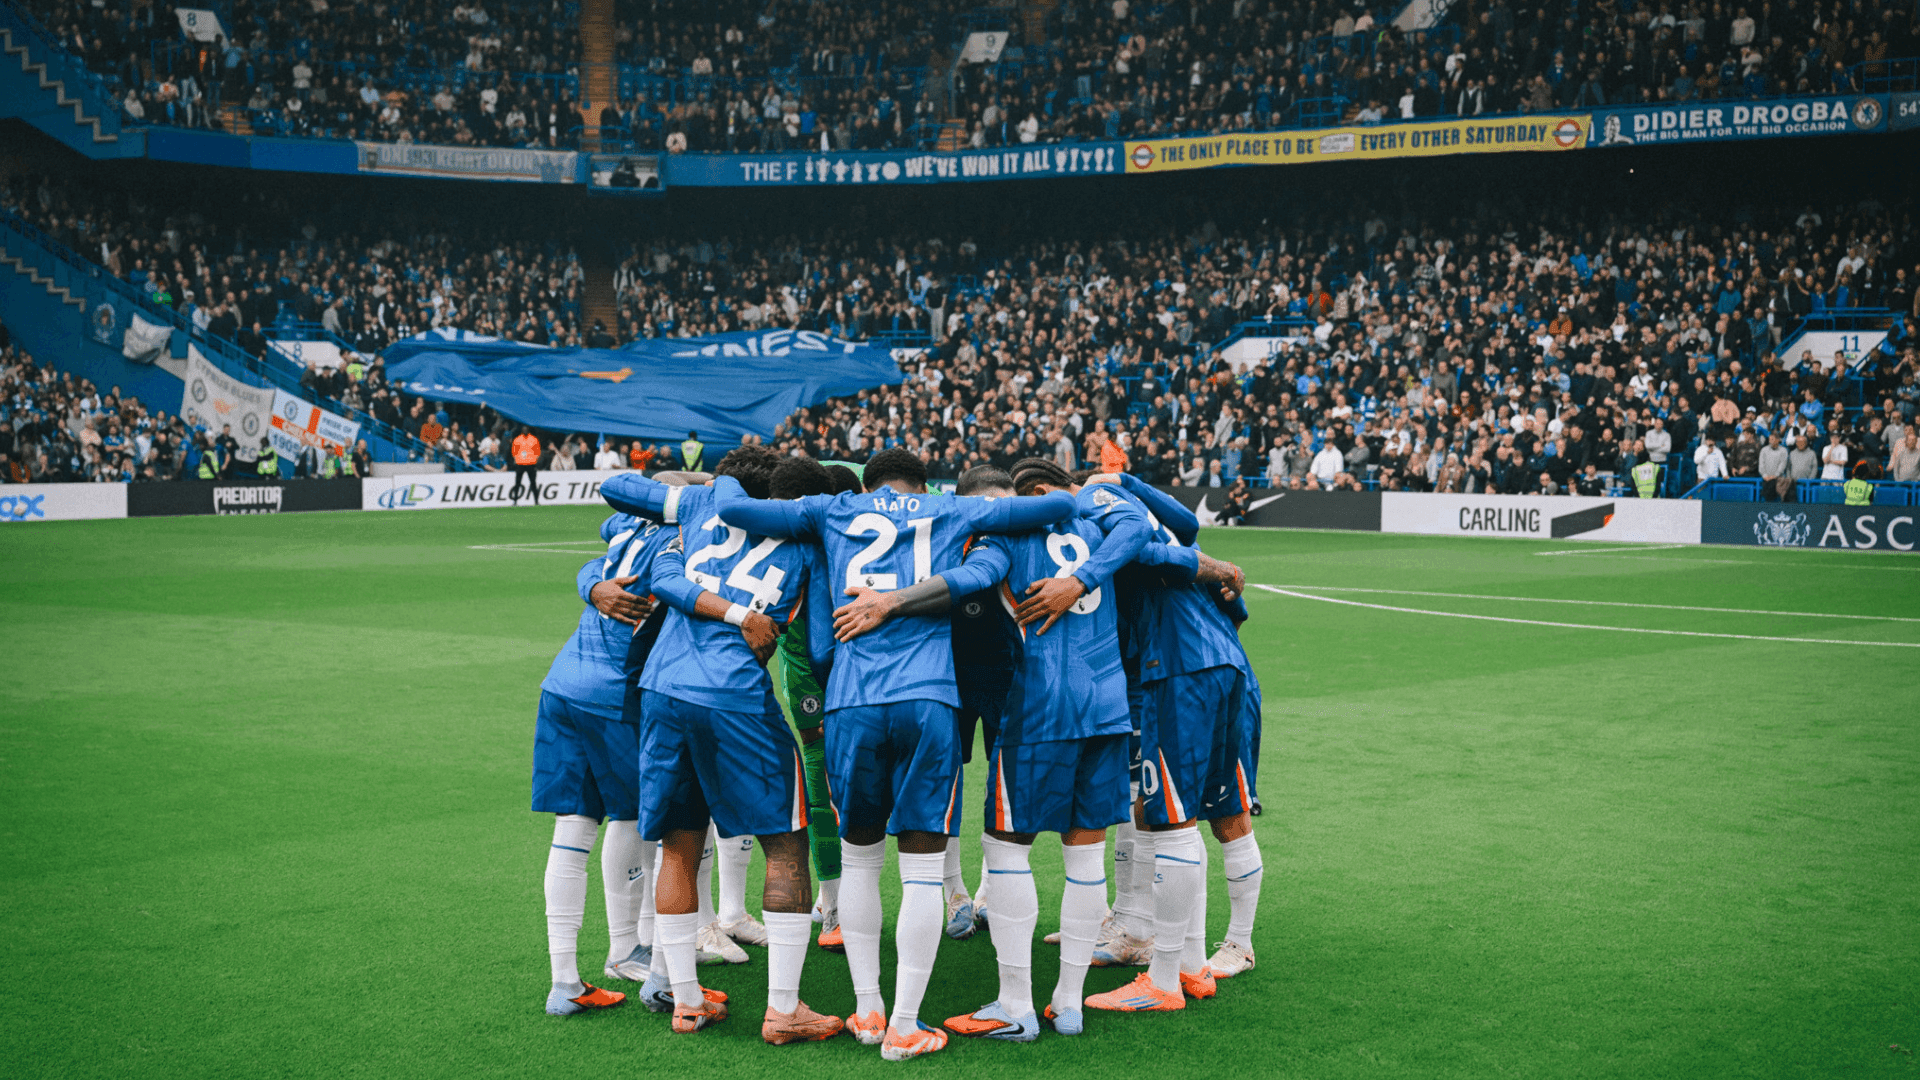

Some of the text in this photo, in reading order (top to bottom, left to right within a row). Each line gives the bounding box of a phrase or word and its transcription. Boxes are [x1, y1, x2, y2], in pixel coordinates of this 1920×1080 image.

[187, 12, 197, 26] 8
[986, 34, 996, 48] 9
[1634, 101, 1848, 132] DIDIER DROGBA
[1900, 101, 1920, 116] 54
[1161, 145, 1185, 163] THE
[1188, 141, 1222, 160] ONLY
[1226, 139, 1269, 156] PLACE
[1273, 138, 1292, 155] TO
[1296, 138, 1314, 155] BE
[1360, 131, 1407, 150] EVERY
[1410, 127, 1460, 148] OTHER
[1465, 124, 1547, 144] SATURDAY
[1635, 121, 1846, 142] THE BIG MAN FOR THE BIG OCCASION
[740, 149, 1050, 181] THE F WE'VE WON IT ALL
[1841, 335, 1861, 352] 11
[213, 486, 282, 514] PREDATOR
[873, 496, 920, 512] HATO
[1459, 507, 1540, 532] CARLING
[1818, 515, 1914, 550] ASC
[685, 514, 787, 614] 24
[845, 512, 933, 590] 21
[1046, 532, 1102, 615] 8
